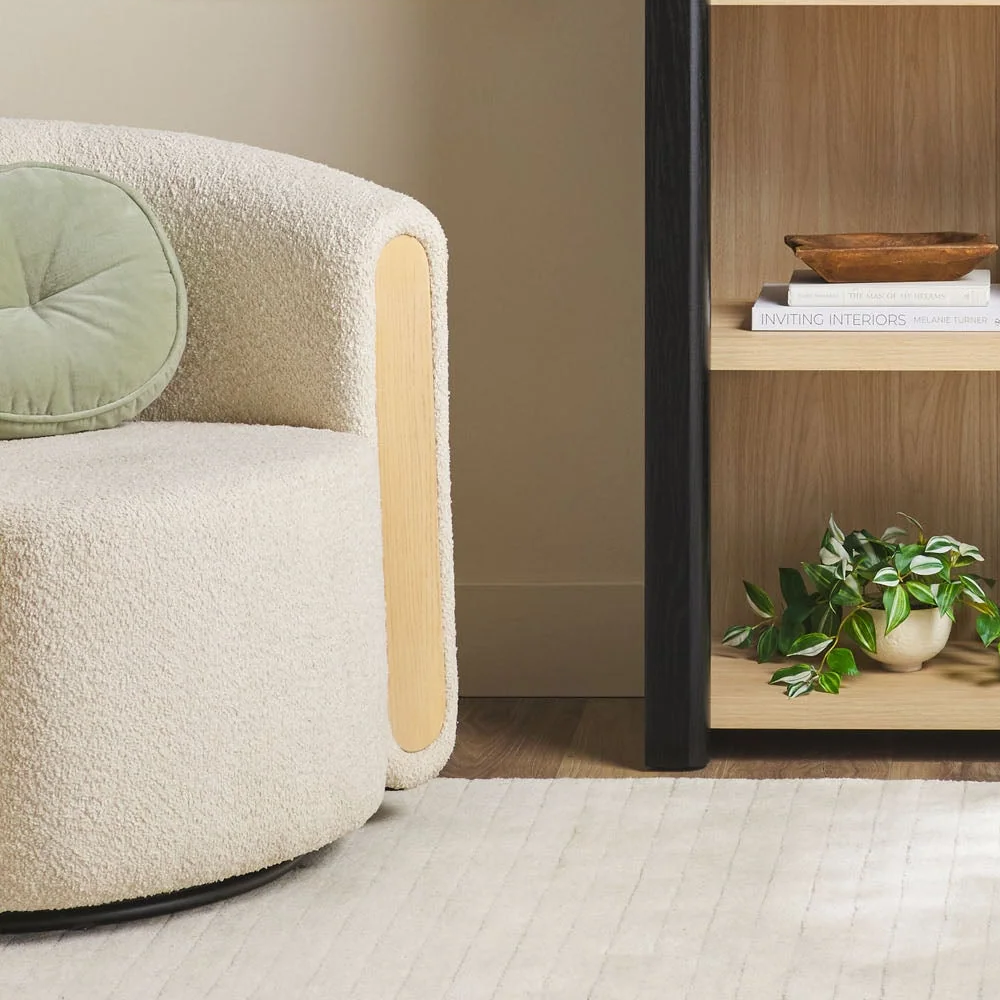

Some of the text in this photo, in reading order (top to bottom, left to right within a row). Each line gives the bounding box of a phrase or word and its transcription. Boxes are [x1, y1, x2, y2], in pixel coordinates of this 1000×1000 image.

[761, 313, 907, 326] INVITING INTERIORS
[913, 315, 951, 325] MELANIE
